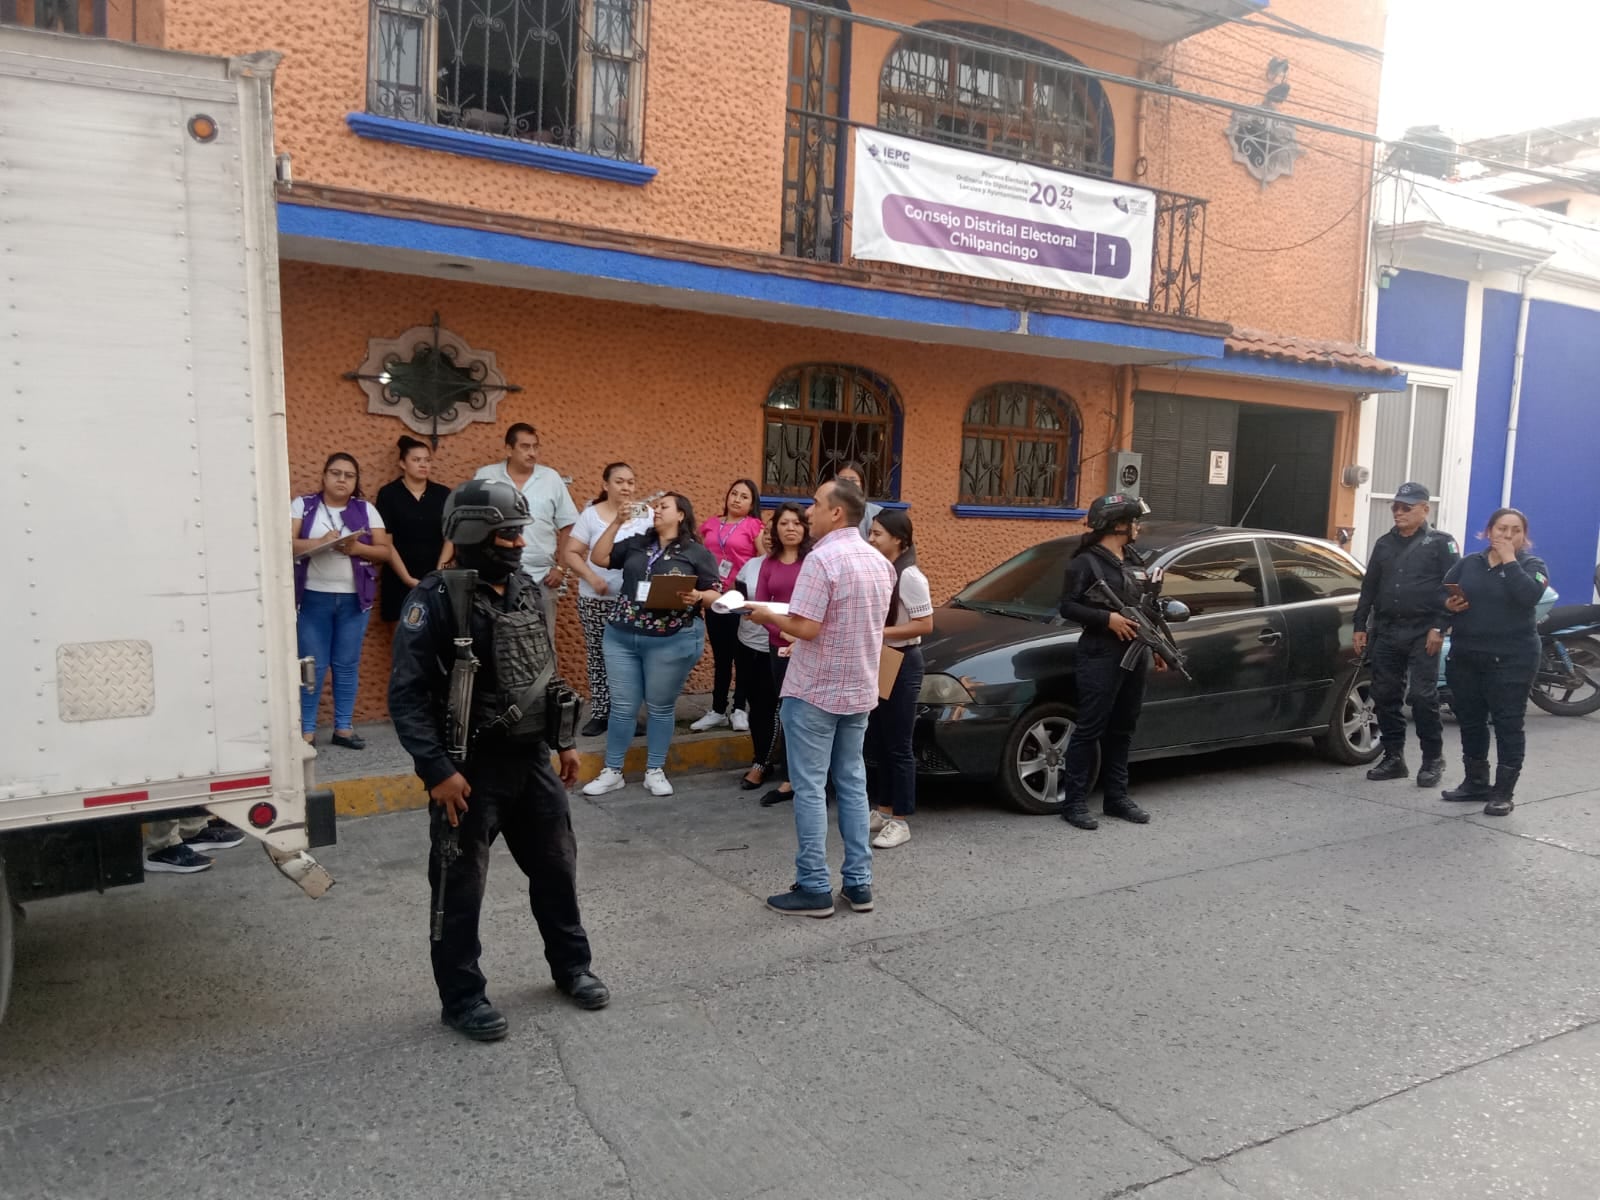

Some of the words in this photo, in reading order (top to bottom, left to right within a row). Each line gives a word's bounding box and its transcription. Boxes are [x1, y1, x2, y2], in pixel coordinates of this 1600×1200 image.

[883, 146, 911, 162] IEPC
[1029, 181, 1058, 207] 20
[1061, 185, 1074, 198] 23
[1059, 199, 1073, 211] 24
[904, 204, 961, 228] Consejo
[964, 215, 1018, 238] Distrital
[1020, 225, 1077, 249] Electoral
[949, 231, 1039, 261] Chilpancingo
[1108, 244, 1117, 266] 1
